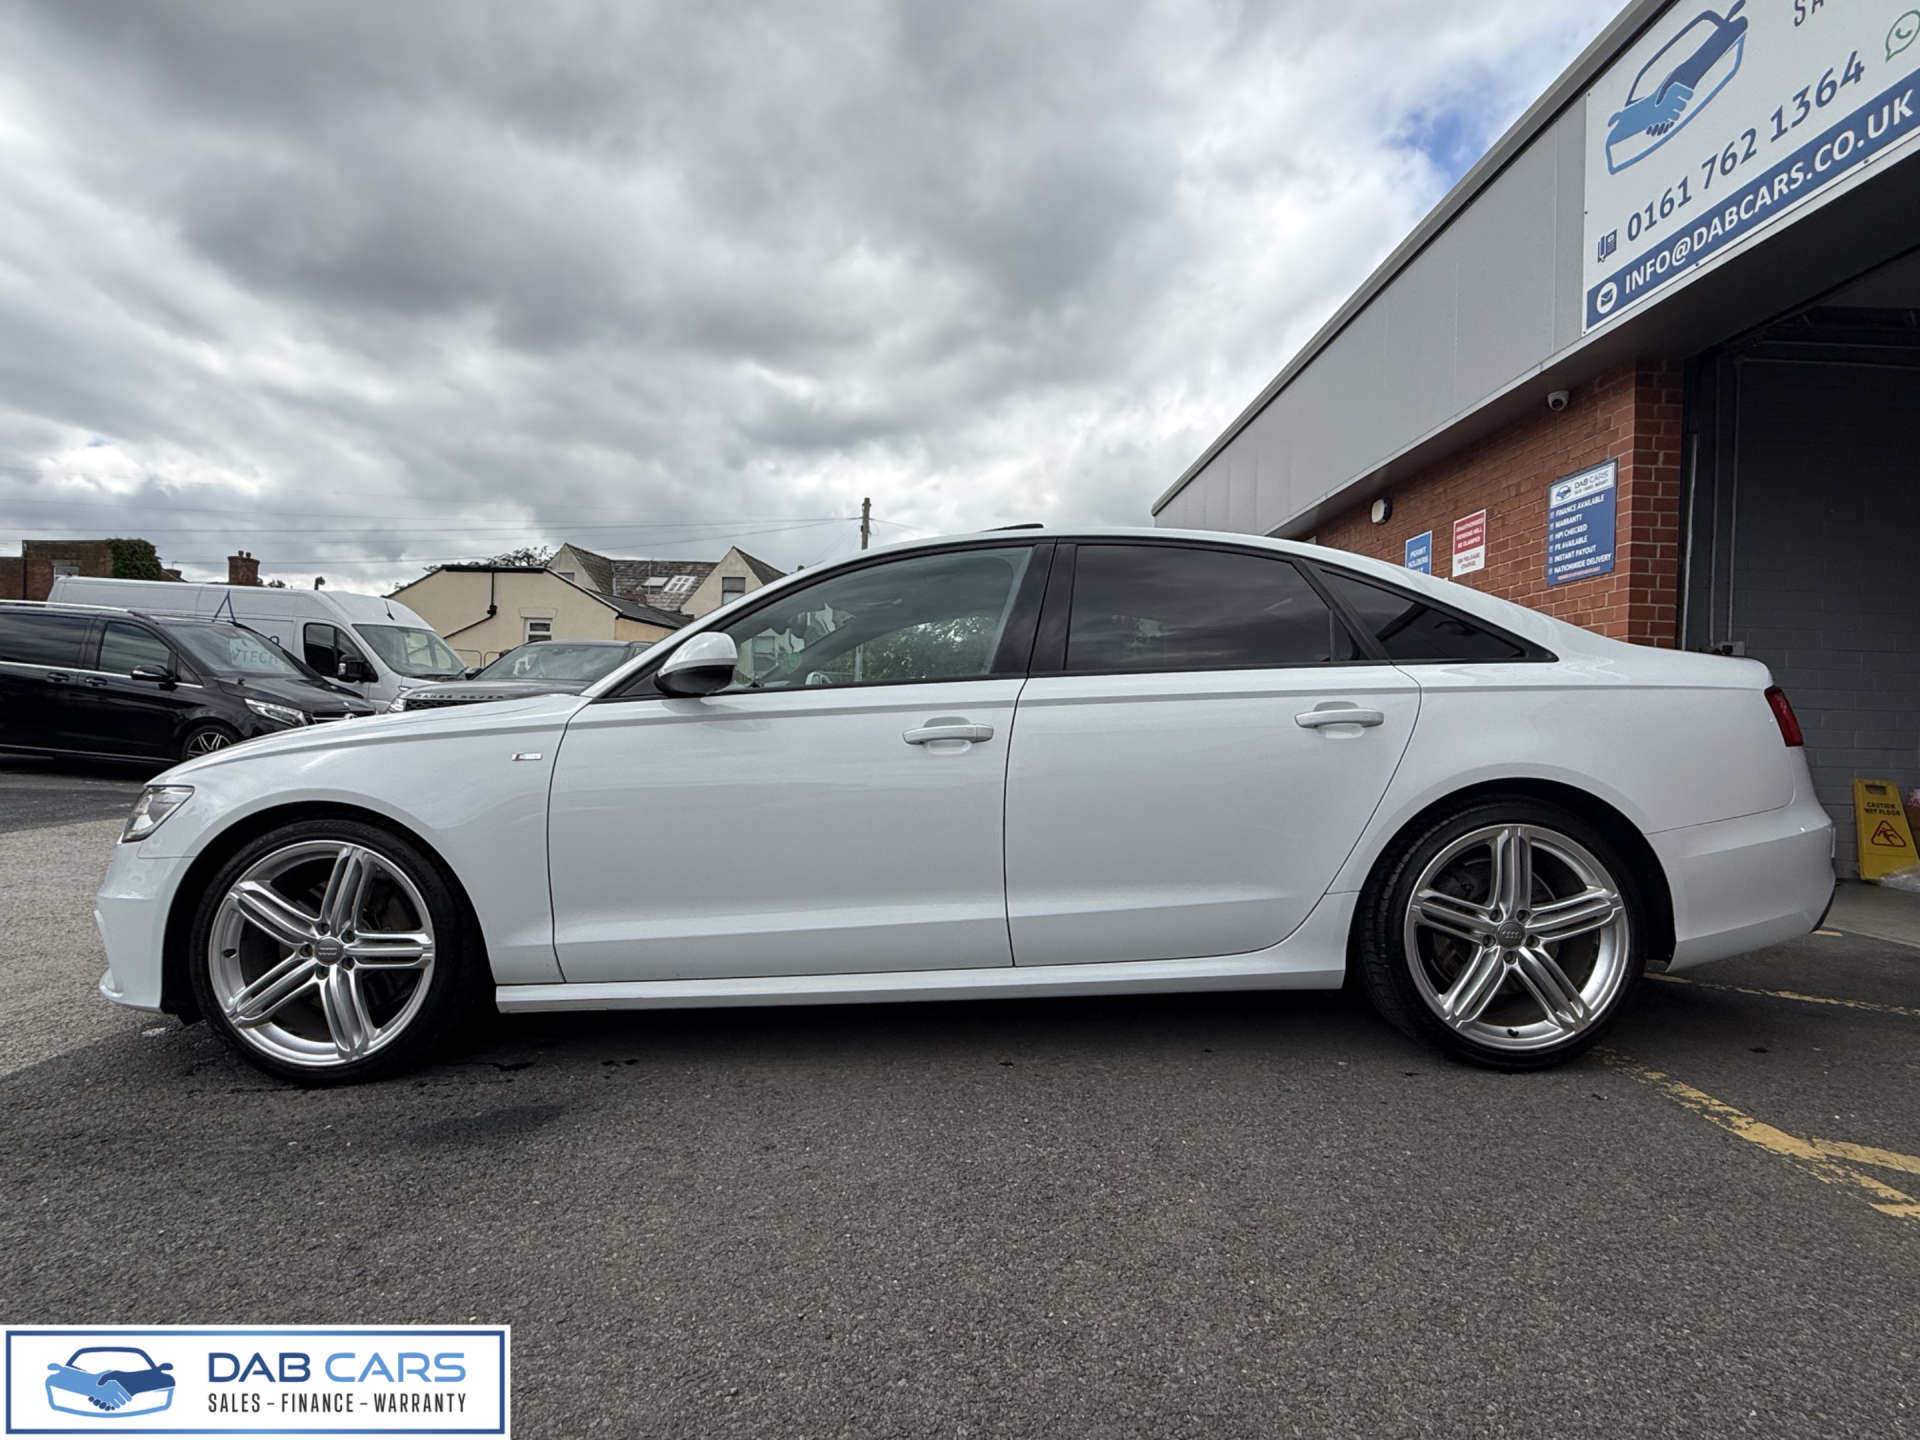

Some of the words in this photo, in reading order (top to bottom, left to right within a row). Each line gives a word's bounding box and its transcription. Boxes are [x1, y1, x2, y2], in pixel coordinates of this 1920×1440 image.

[1625, 90, 1913, 294] INFO@DABCARS.CO.UK
[1627, 176, 1692, 241] 0161
[1701, 127, 1757, 190] 762
[1769, 50, 1865, 143] 1364
